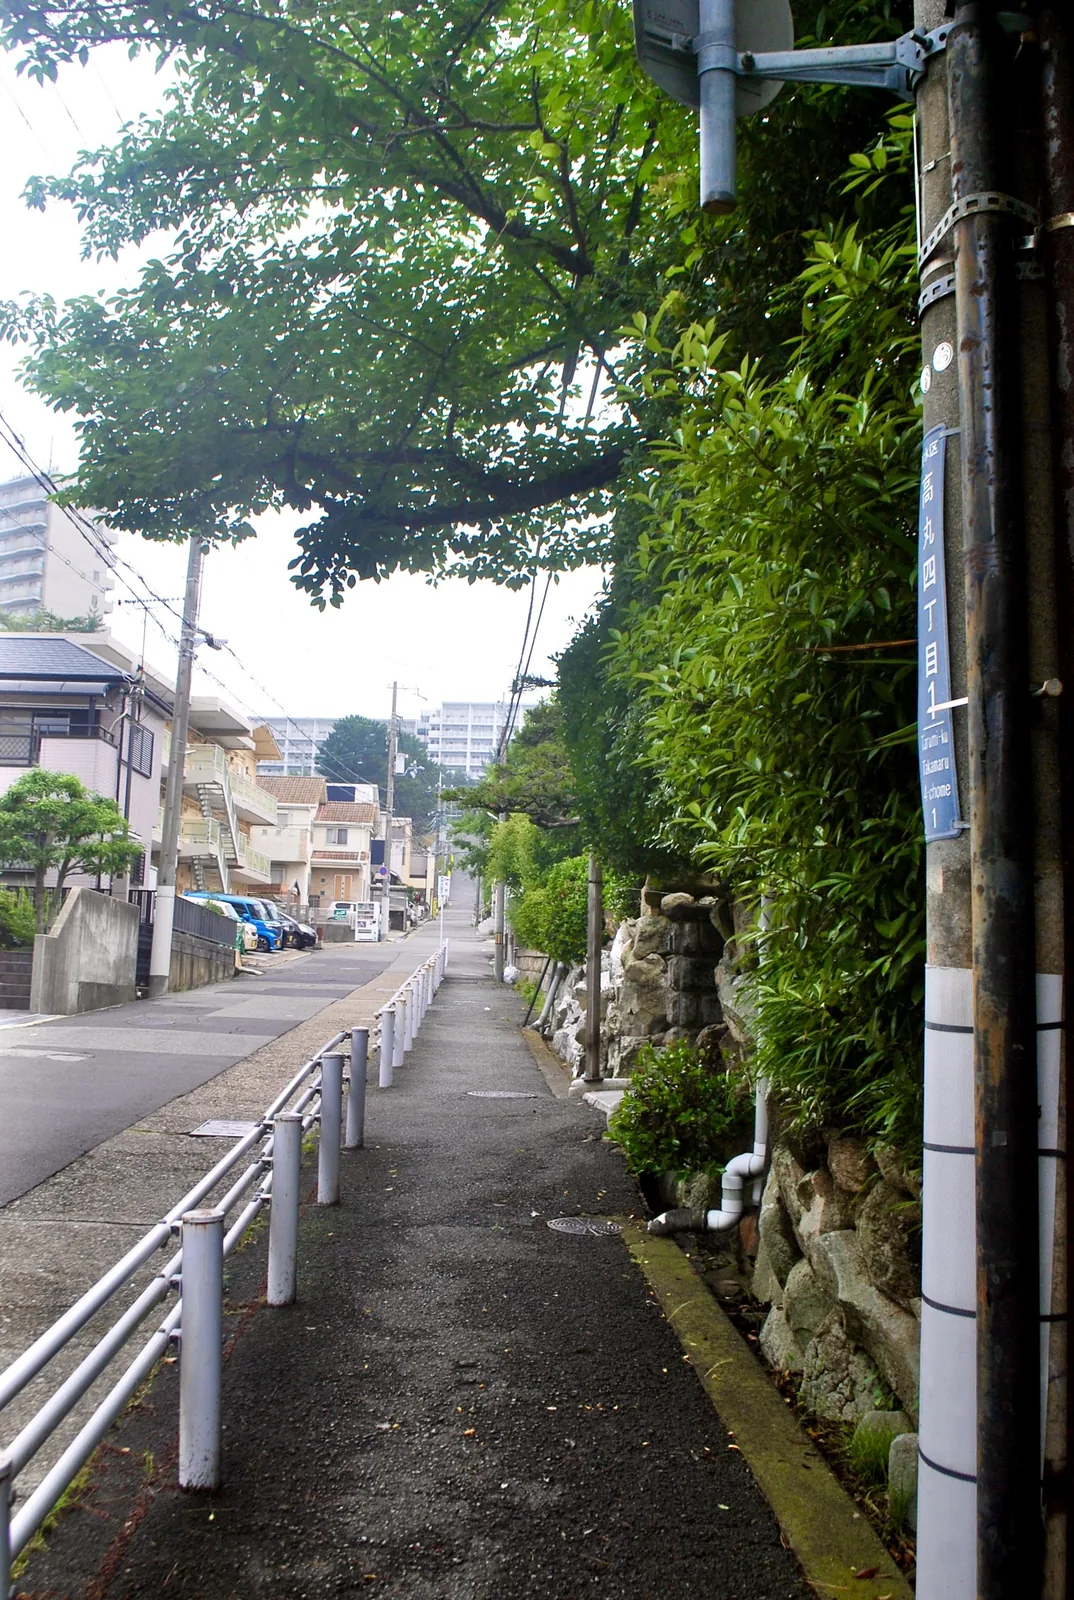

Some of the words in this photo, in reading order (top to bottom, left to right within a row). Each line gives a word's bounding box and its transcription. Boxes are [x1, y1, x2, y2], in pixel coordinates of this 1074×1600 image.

[922, 756, 950, 777] Takamaru
[924, 782, 952, 802] 4-chome
[931, 807, 938, 829] 1
